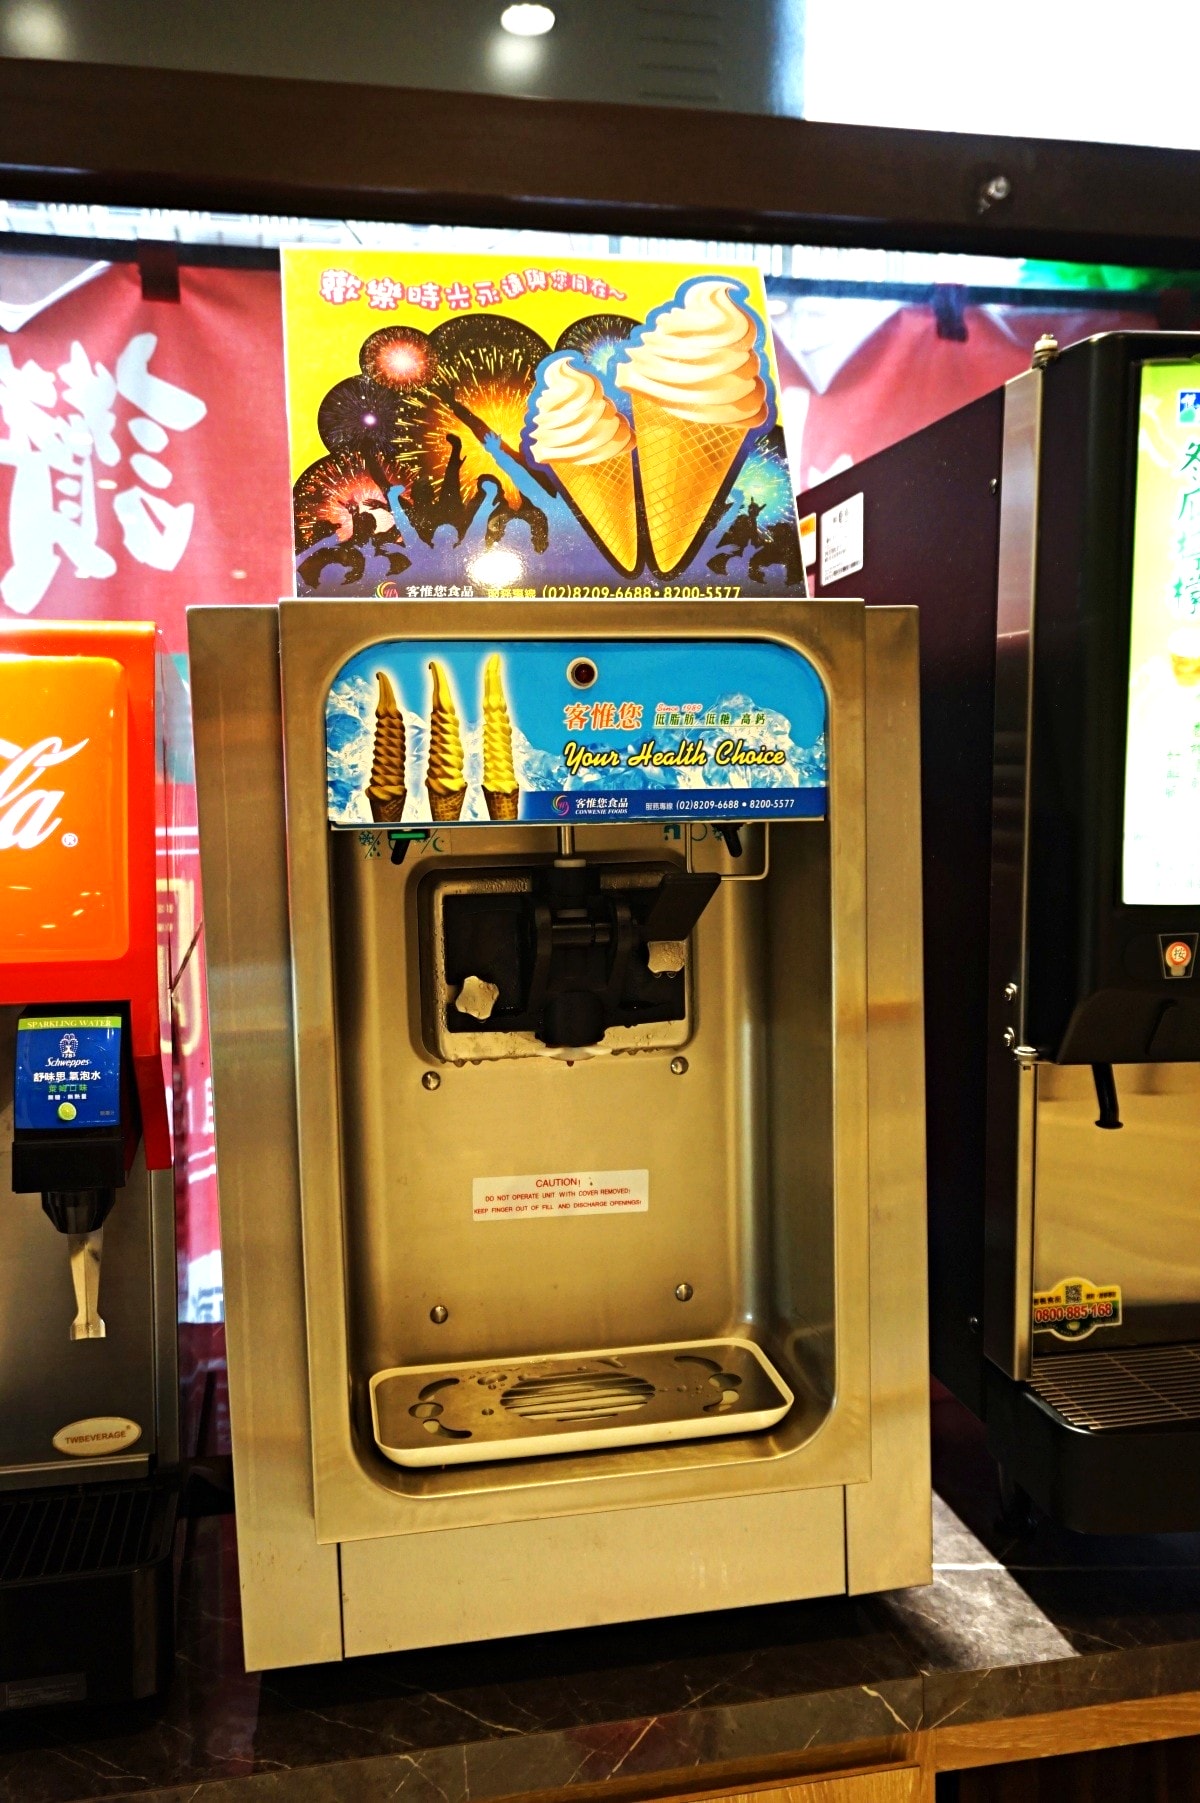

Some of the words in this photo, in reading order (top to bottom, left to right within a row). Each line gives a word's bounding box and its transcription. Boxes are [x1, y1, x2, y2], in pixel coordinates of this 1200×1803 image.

[682, 702, 702, 712] 1989
[563, 701, 643, 730] 客惟您
[563, 740, 619, 776] Your
[628, 739, 707, 767] Health
[714, 739, 785, 766] Choice
[575, 797, 628, 808] 客惟您食品
[676, 800, 739, 811] (02)8209-6688
[749, 799, 795, 809] 8200-5577
[27, 1019, 77, 1028] SPARKLING
[79, 1019, 111, 1027] WATER
[45, 1057, 90, 1067] Schweppes
[536, 1177, 581, 1188] CAUTION!
[579, 1189, 598, 1197] COVER
[65, 1430, 126, 1444] TWBEVERAGE
